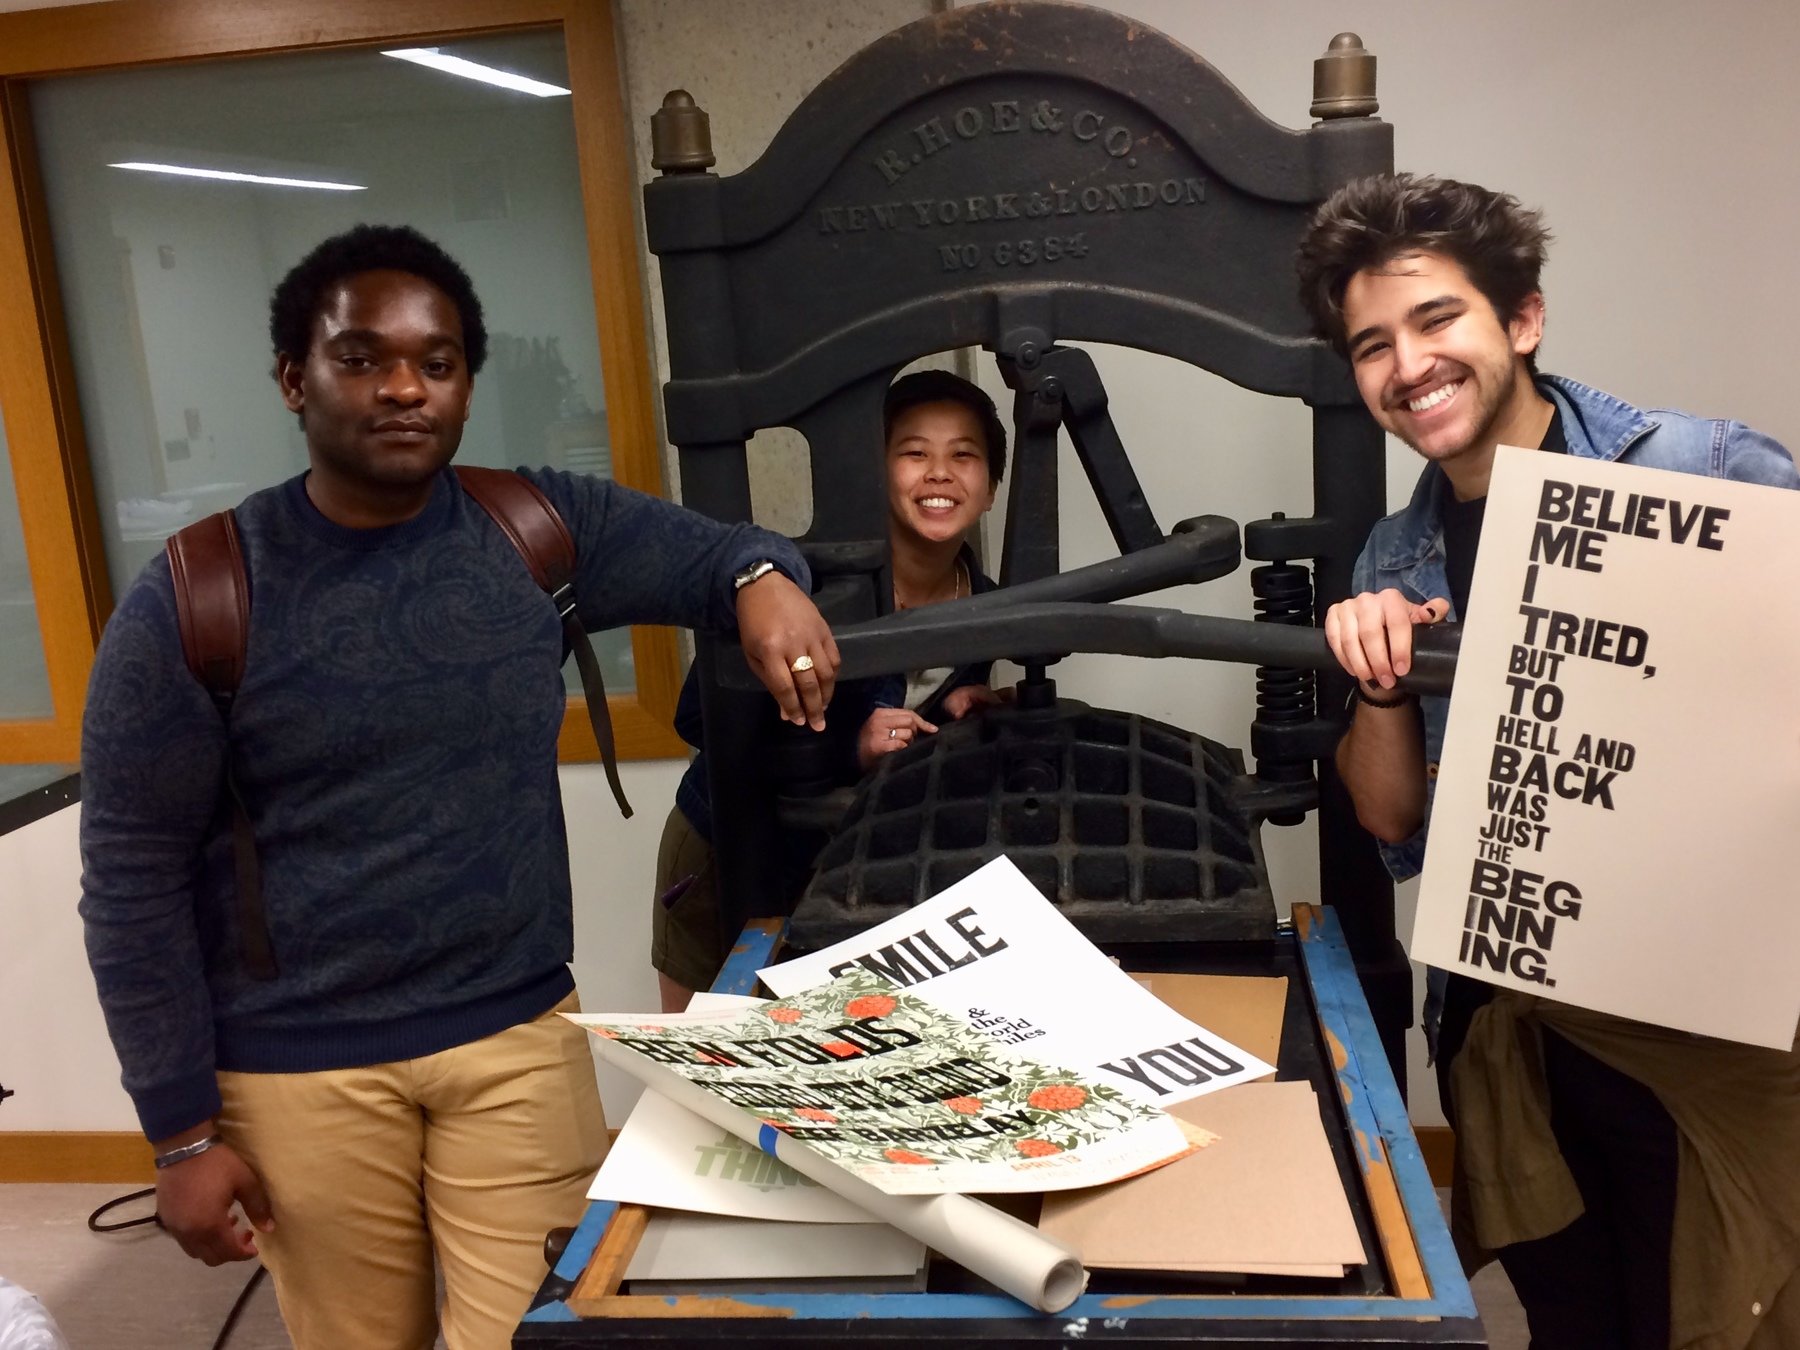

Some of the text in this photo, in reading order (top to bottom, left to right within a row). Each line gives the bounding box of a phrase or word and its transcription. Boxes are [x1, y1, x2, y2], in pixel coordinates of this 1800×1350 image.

[818, 203, 902, 233] NEW
[1537, 479, 1731, 551] BELIEVE
[1529, 521, 1608, 573] ME
[1521, 564, 1540, 603] I
[1508, 644, 1565, 682] BUT
[1519, 604, 1657, 679] TRIED,
[1505, 674, 1564, 722] TO
[1495, 714, 1636, 772] HELL AND
[1489, 744, 1618, 810] BACK
[1487, 782, 1548, 822] WAS
[1478, 839, 1514, 864] THE
[1480, 813, 1551, 852] JUST
[1469, 858, 1583, 921] BEG
[1464, 894, 1557, 951] INN
[1458, 930, 1557, 987] ING.
[968, 1007, 991, 1019] &
[971, 1016, 1007, 1030] the
[986, 1018, 1033, 1036] orld
[607, 1016, 923, 1067] BEN FOLDS
[875, 1057, 1012, 1105] BLIND
[1097, 1037, 1245, 1096] YOU
[851, 1109, 1037, 1142] BARZELAY
